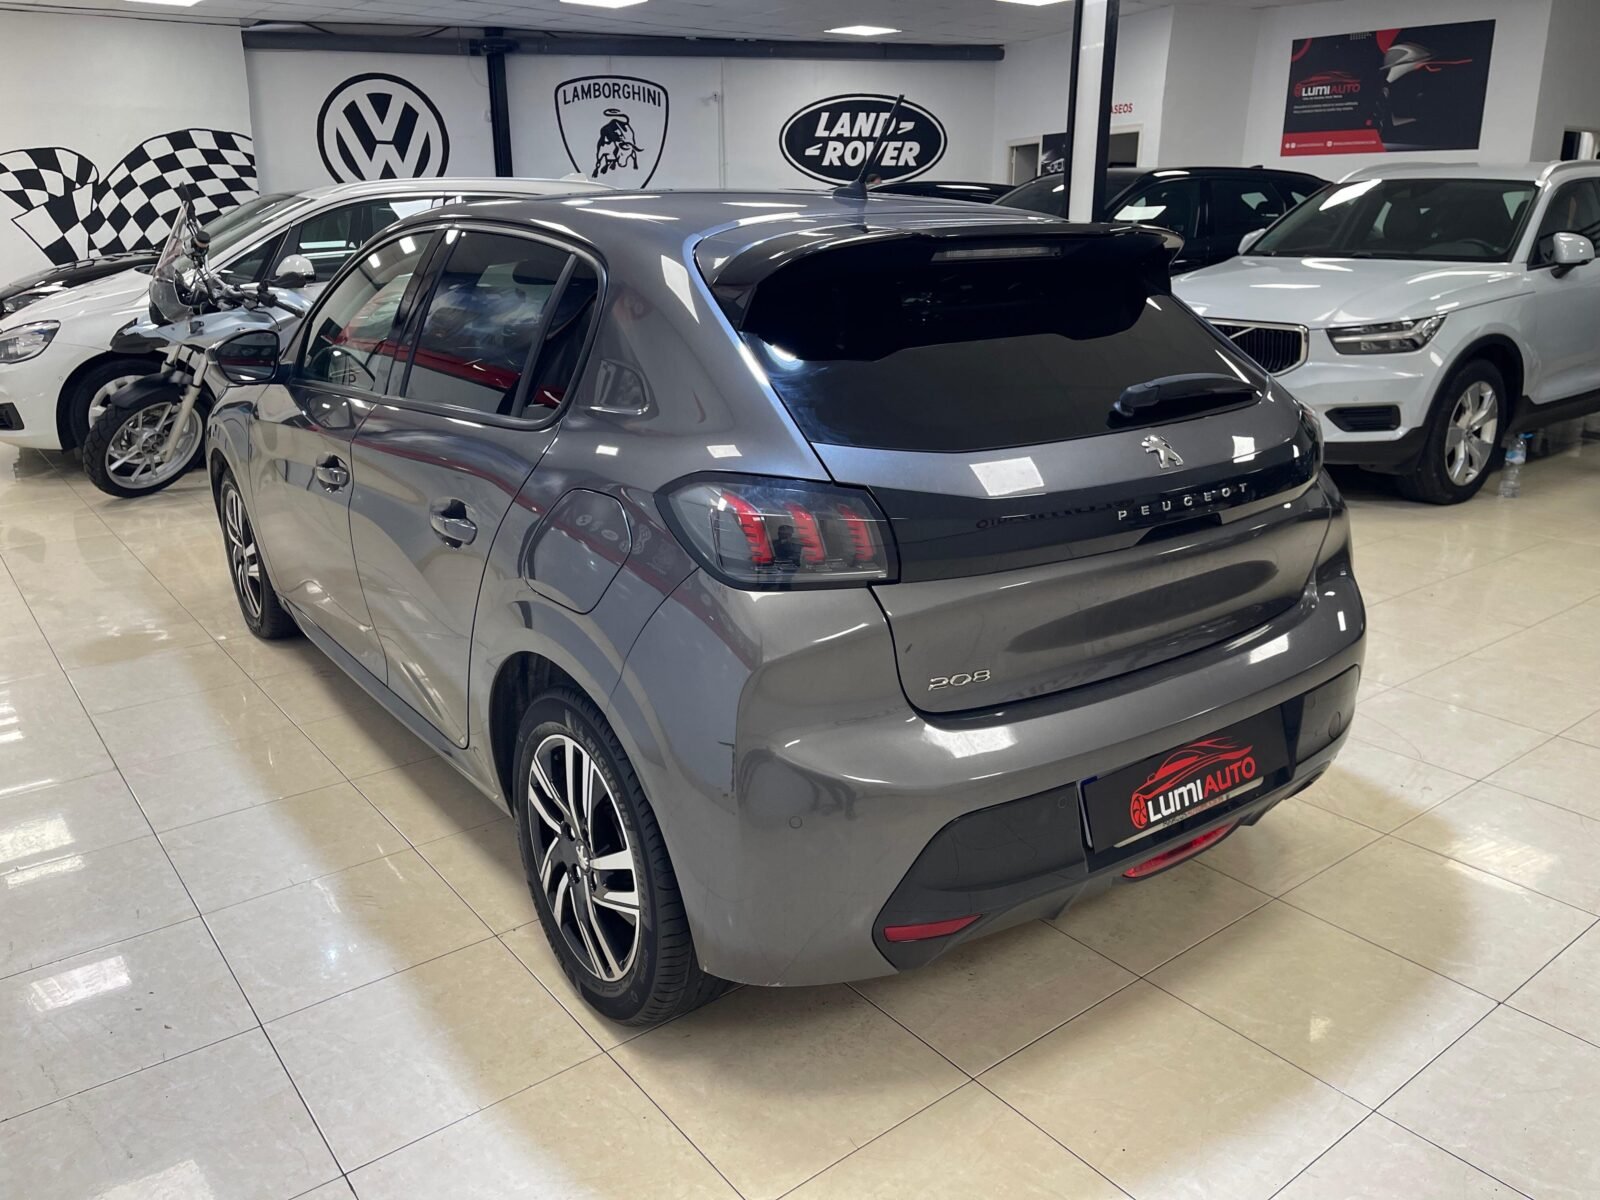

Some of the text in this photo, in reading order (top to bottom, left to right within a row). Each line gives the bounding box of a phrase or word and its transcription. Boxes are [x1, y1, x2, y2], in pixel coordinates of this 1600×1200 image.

[562, 82, 661, 107] LAMBORGHINI
[814, 111, 897, 137] LAND
[821, 140, 921, 167] ROVER
[1118, 483, 1247, 520] PEUGEOT
[928, 669, 991, 691] 208
